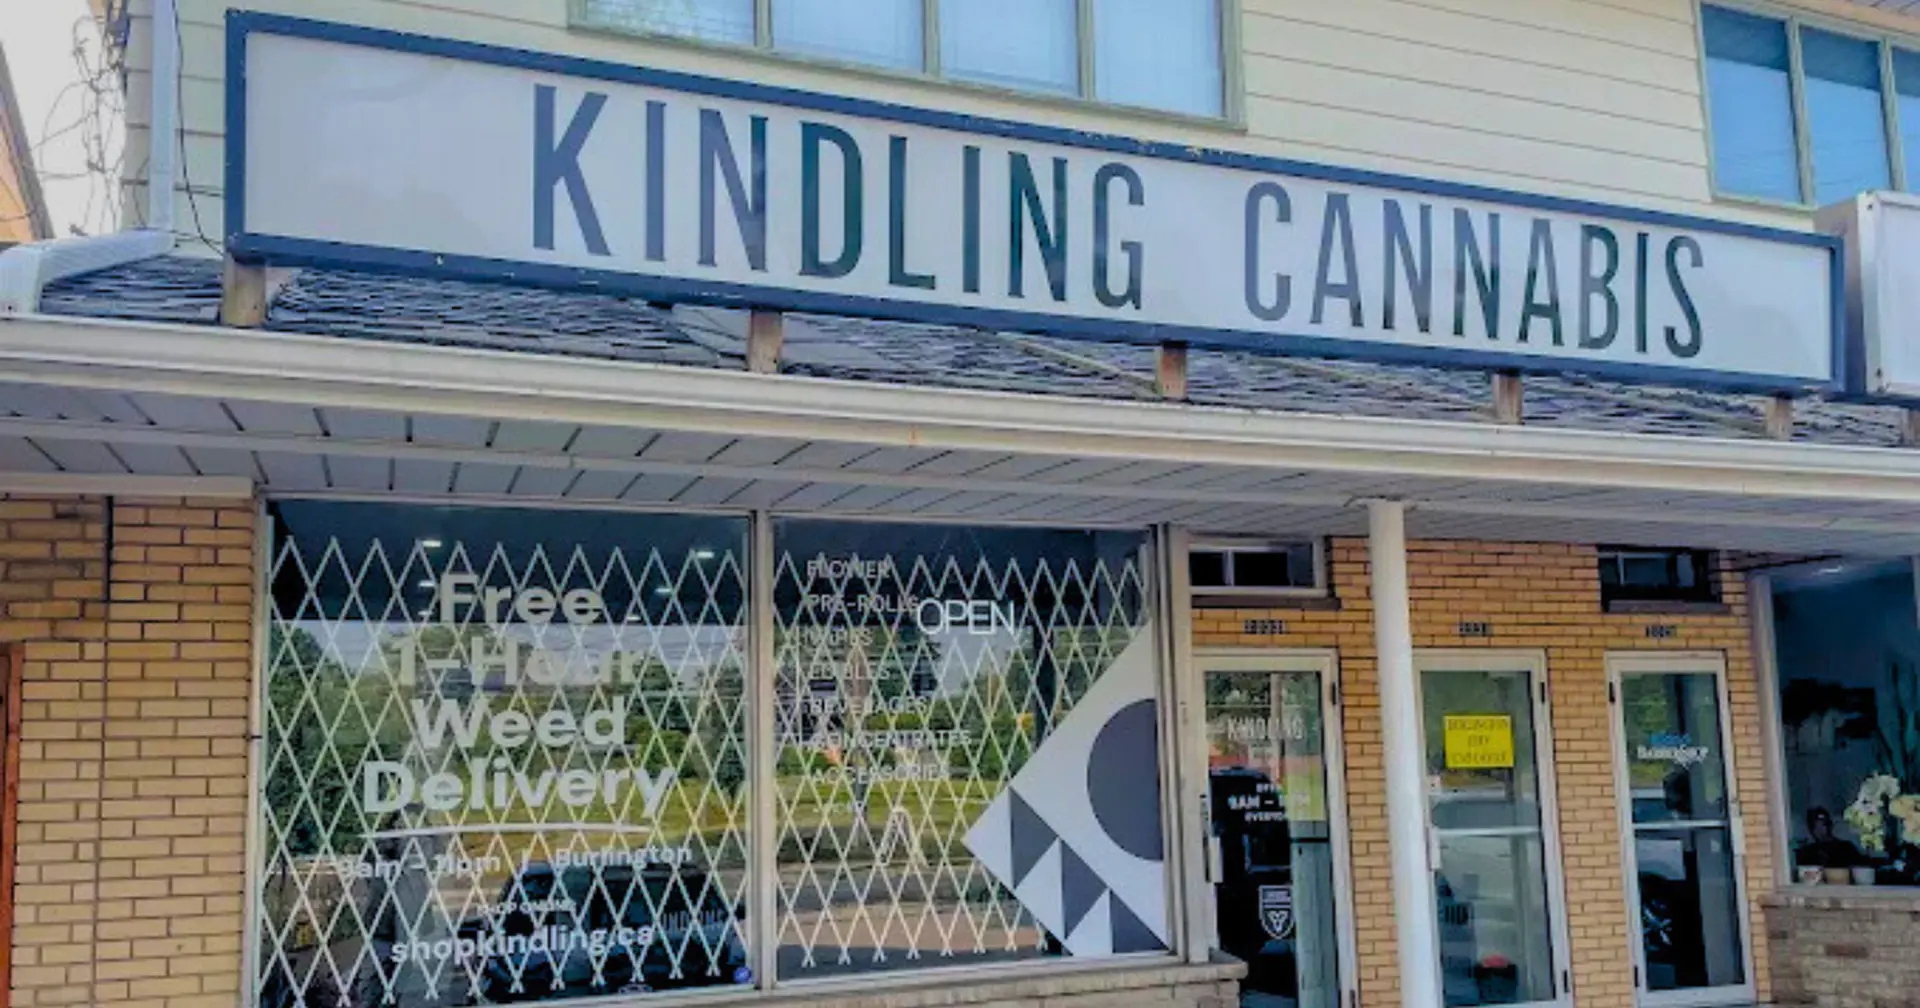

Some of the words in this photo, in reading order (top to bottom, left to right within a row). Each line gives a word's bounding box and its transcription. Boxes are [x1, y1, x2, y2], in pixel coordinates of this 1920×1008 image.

[533, 84, 1146, 310] KINDLING
[1244, 181, 1704, 359] CANNABIS
[807, 560, 890, 579] FLOWER
[440, 571, 604, 625] Free
[916, 598, 1016, 636] OPEN
[391, 634, 645, 686] 1-Hour
[412, 695, 627, 749] Weed
[363, 756, 678, 819] Delivery
[555, 845, 693, 870] Burlington
[391, 926, 656, 966] shopkindling.ca
